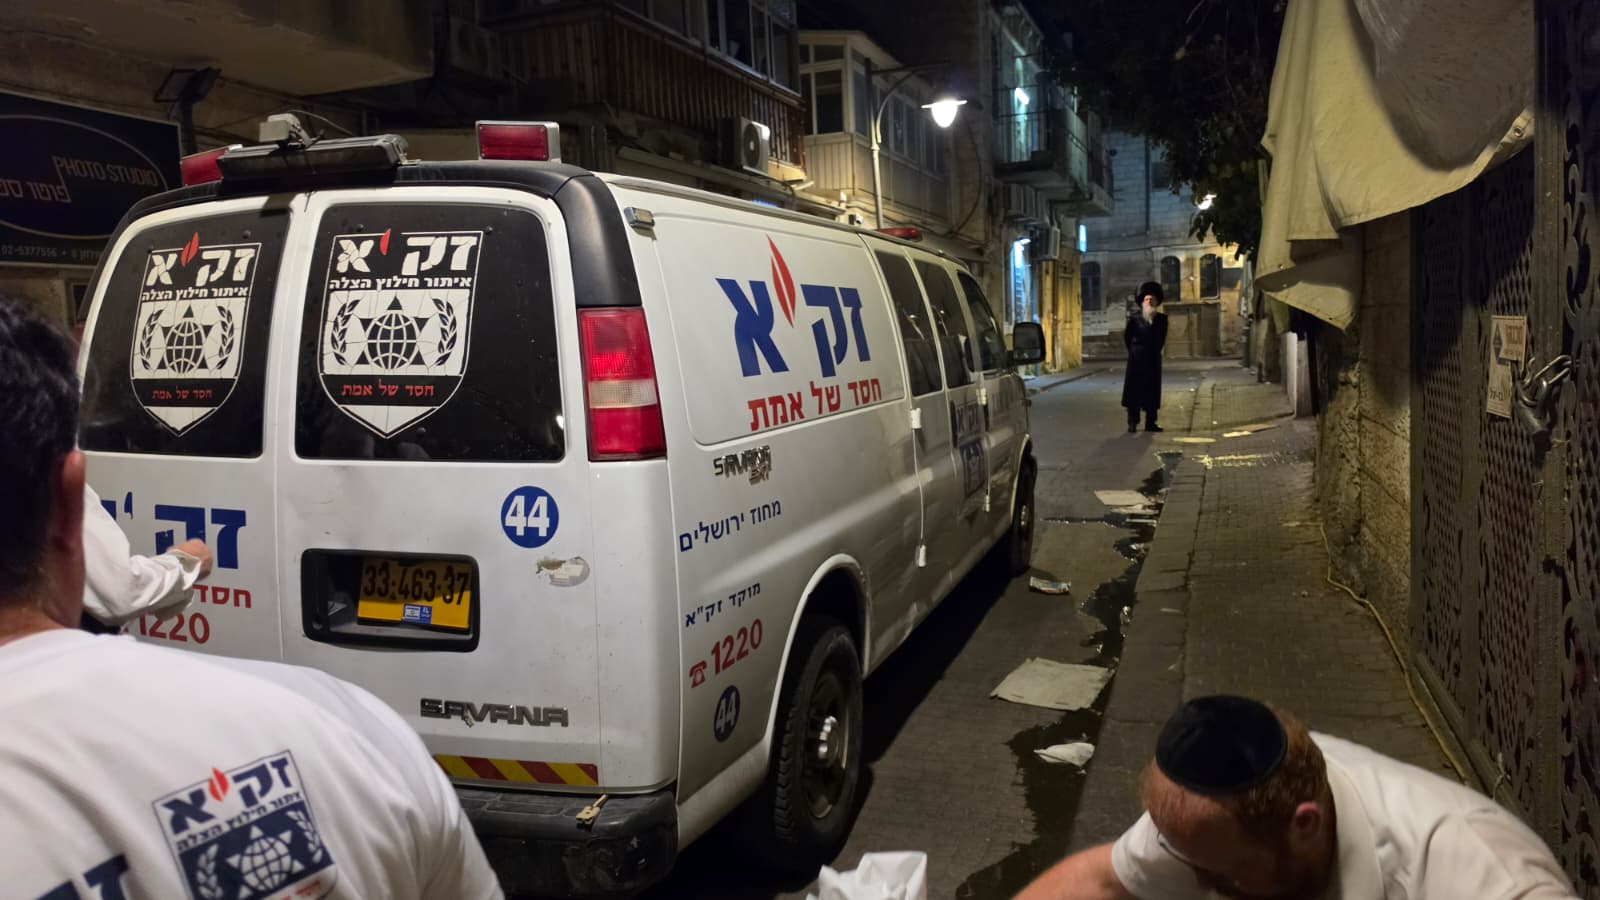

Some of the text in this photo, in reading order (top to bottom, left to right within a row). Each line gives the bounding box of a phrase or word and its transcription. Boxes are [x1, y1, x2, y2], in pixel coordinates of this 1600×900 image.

[51, 155, 161, 188] PHOTO STUDIO
[141, 286, 250, 302] איתור חילוץ הצלה
[329, 275, 472, 291] איתור חילוץ הצלה
[151, 385, 214, 400] חסד של אמת
[341, 379, 434, 397] חסד של אמת
[747, 378, 882, 431] חסד של אמת
[504, 495, 551, 537] 44
[679, 500, 782, 552] מחוז ירושלים
[192, 584, 252, 609] חסד
[685, 582, 761, 628] מוקד זק"א
[139, 612, 210, 644] 1220
[711, 618, 763, 676] 1220
[420, 698, 569, 728] SAVANA
[716, 692, 737, 734] 44
[226, 804, 267, 830] חילוץ
[176, 824, 222, 852] הצלה
